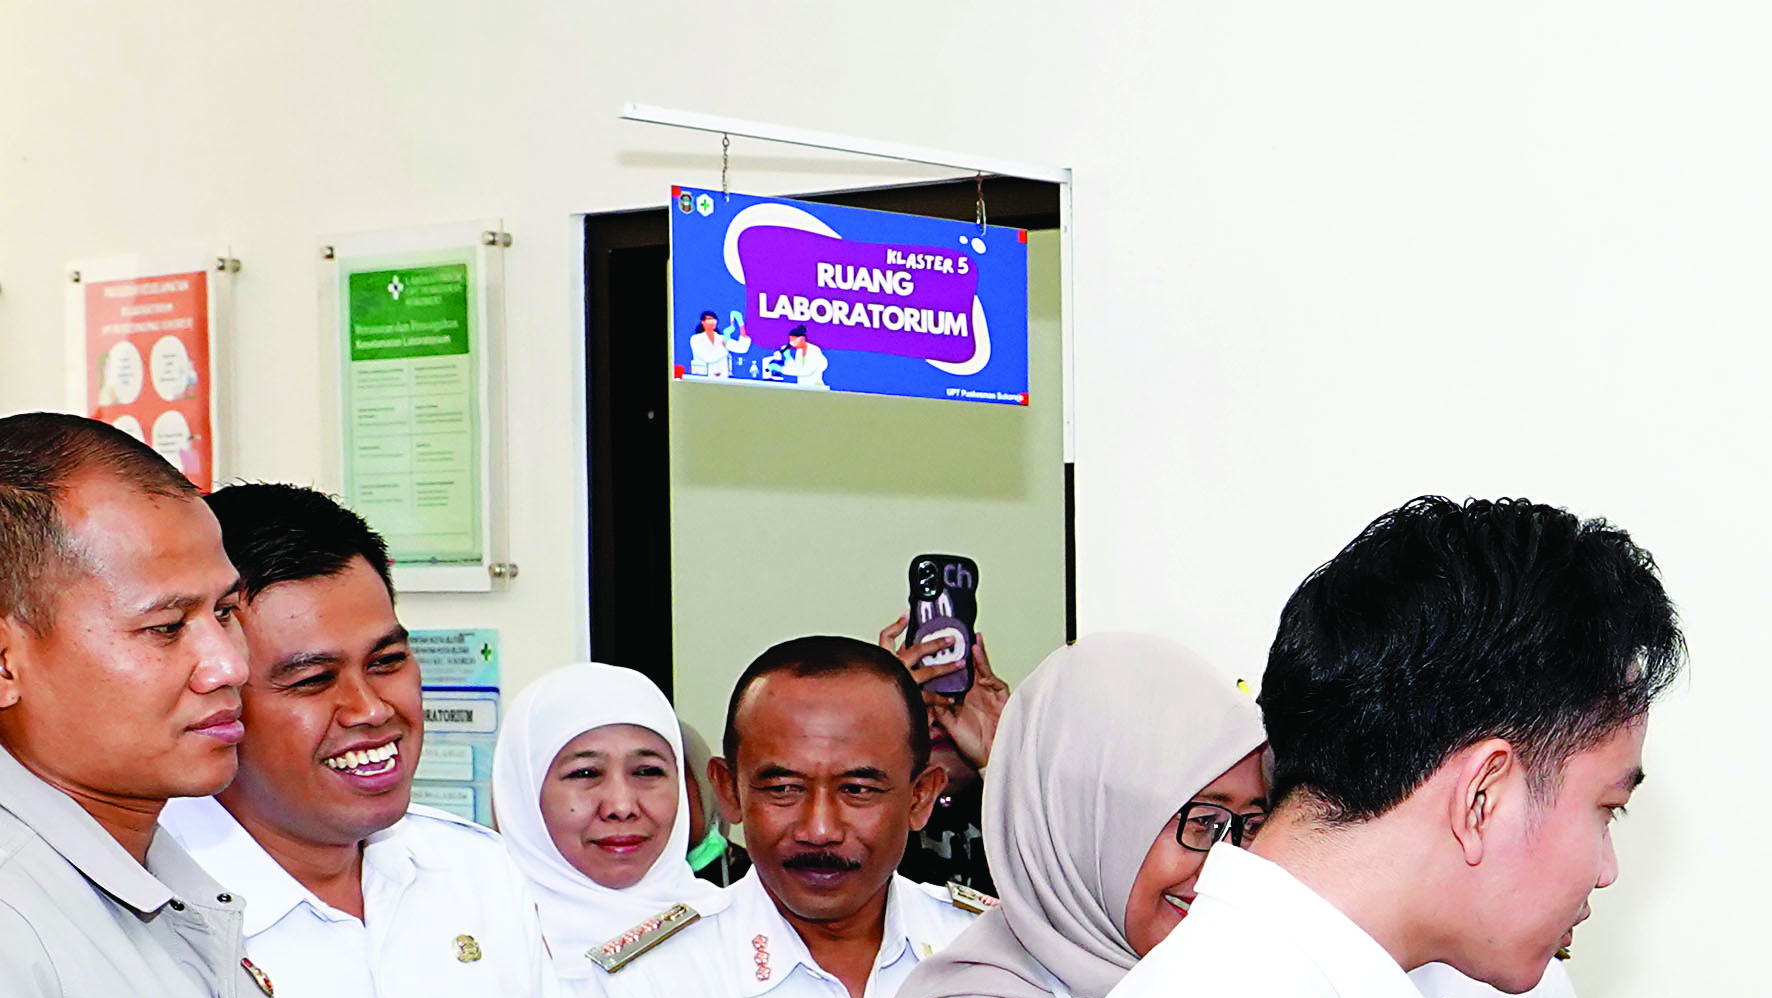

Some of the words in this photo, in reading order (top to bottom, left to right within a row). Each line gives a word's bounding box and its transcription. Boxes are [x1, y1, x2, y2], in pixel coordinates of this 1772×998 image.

[887, 249, 954, 274] KLASTER
[957, 257, 969, 274] 5
[817, 262, 914, 296] RUANG
[759, 293, 968, 337] LABORATORIUM
[423, 709, 473, 722] RATORIUM
